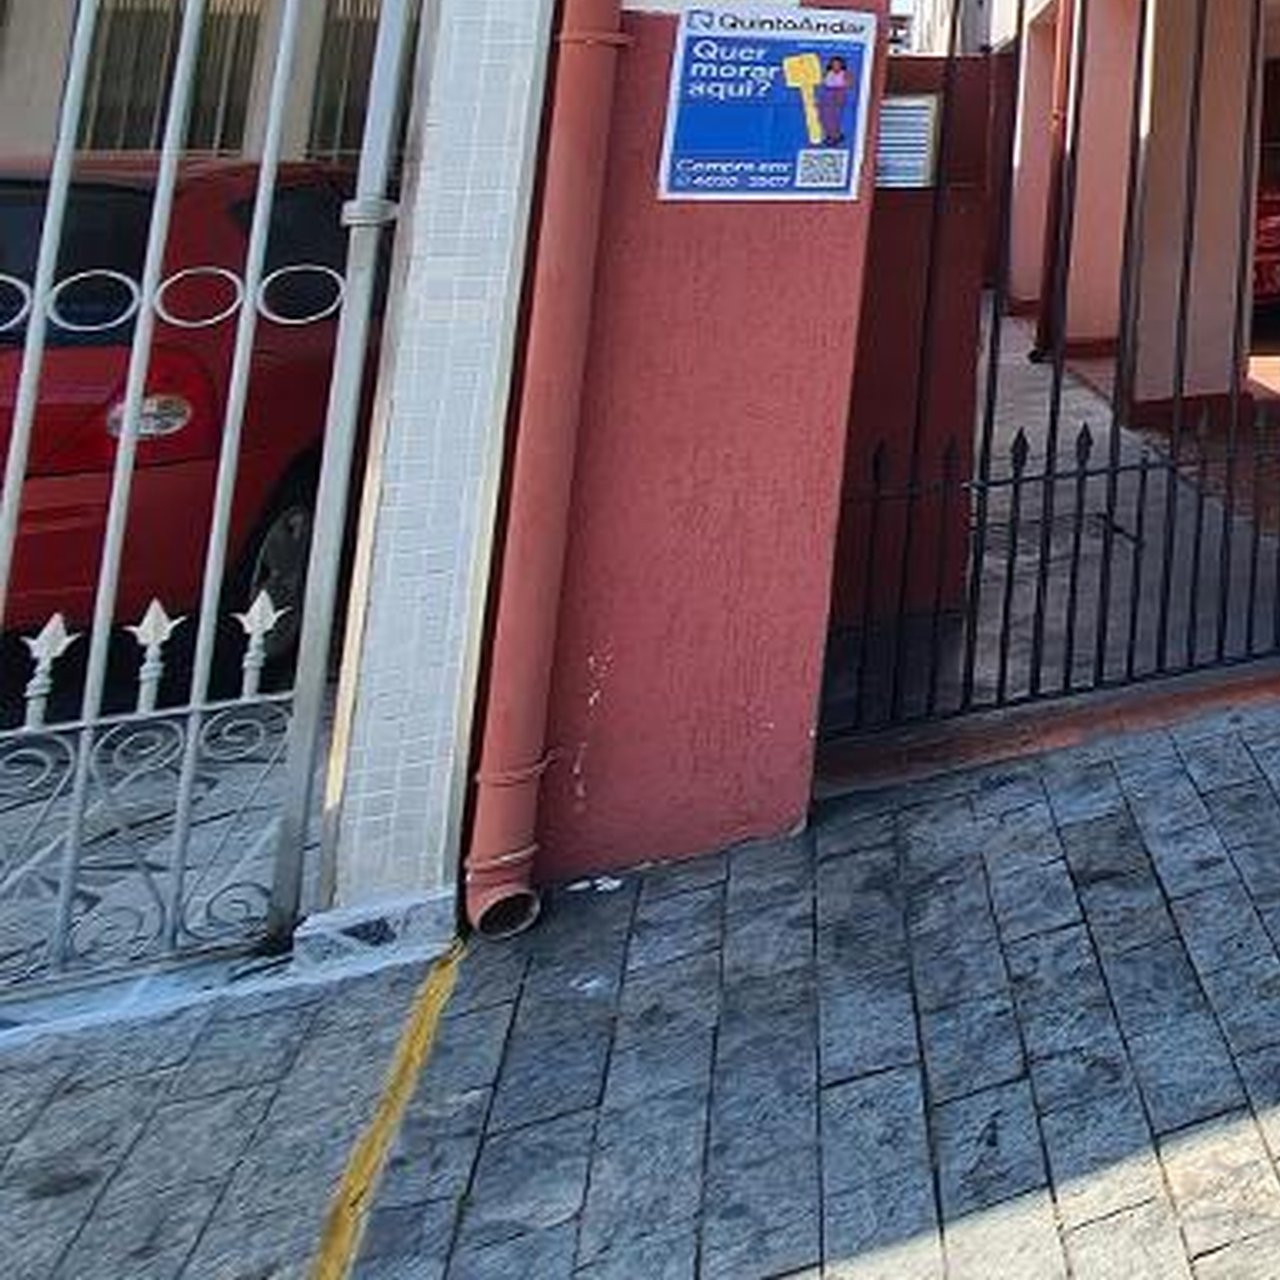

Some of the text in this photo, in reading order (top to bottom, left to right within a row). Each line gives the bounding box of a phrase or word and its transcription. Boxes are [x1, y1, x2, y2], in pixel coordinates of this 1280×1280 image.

[719, 13, 865, 34] QuintoAndar
[693, 40, 767, 62] Quer
[691, 63, 781, 80] morar
[689, 80, 771, 100] aqui?
